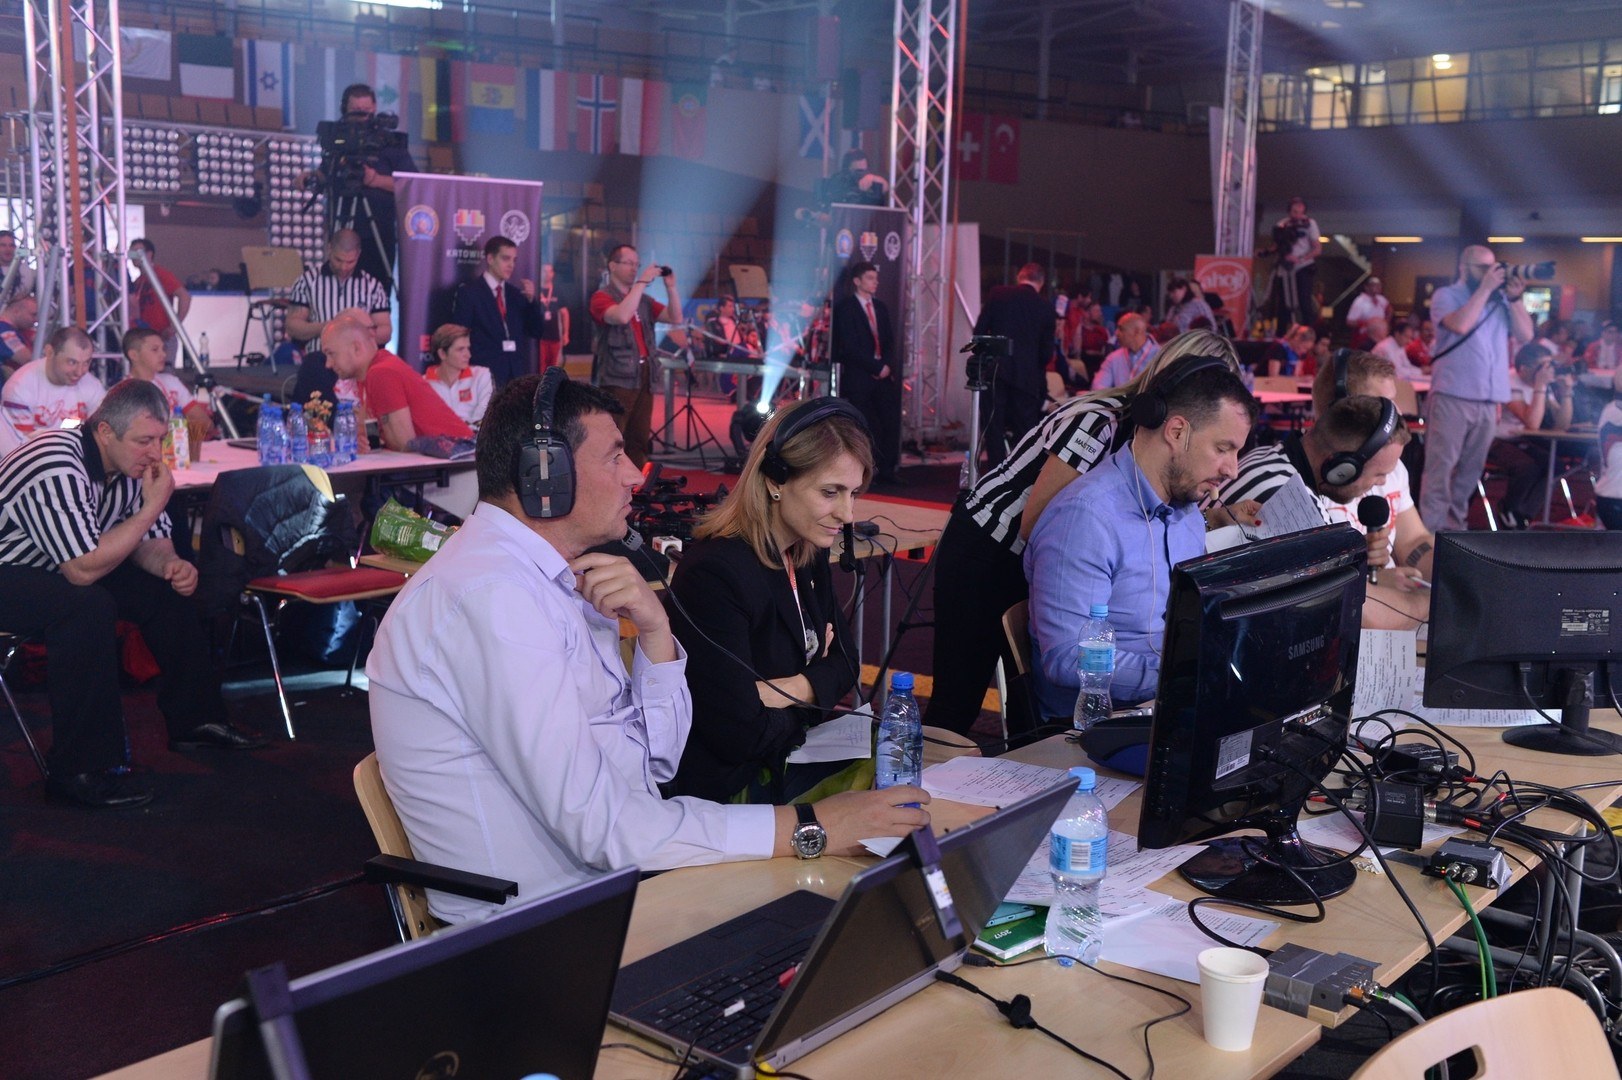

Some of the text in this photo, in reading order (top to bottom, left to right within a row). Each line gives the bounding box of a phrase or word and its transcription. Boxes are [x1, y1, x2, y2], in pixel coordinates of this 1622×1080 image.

[446, 249, 486, 259] KATOWIC
[1074, 437, 1097, 455] MASTER
[1288, 634, 1325, 660] SAMSUNG
[994, 929, 1012, 939] 2017
